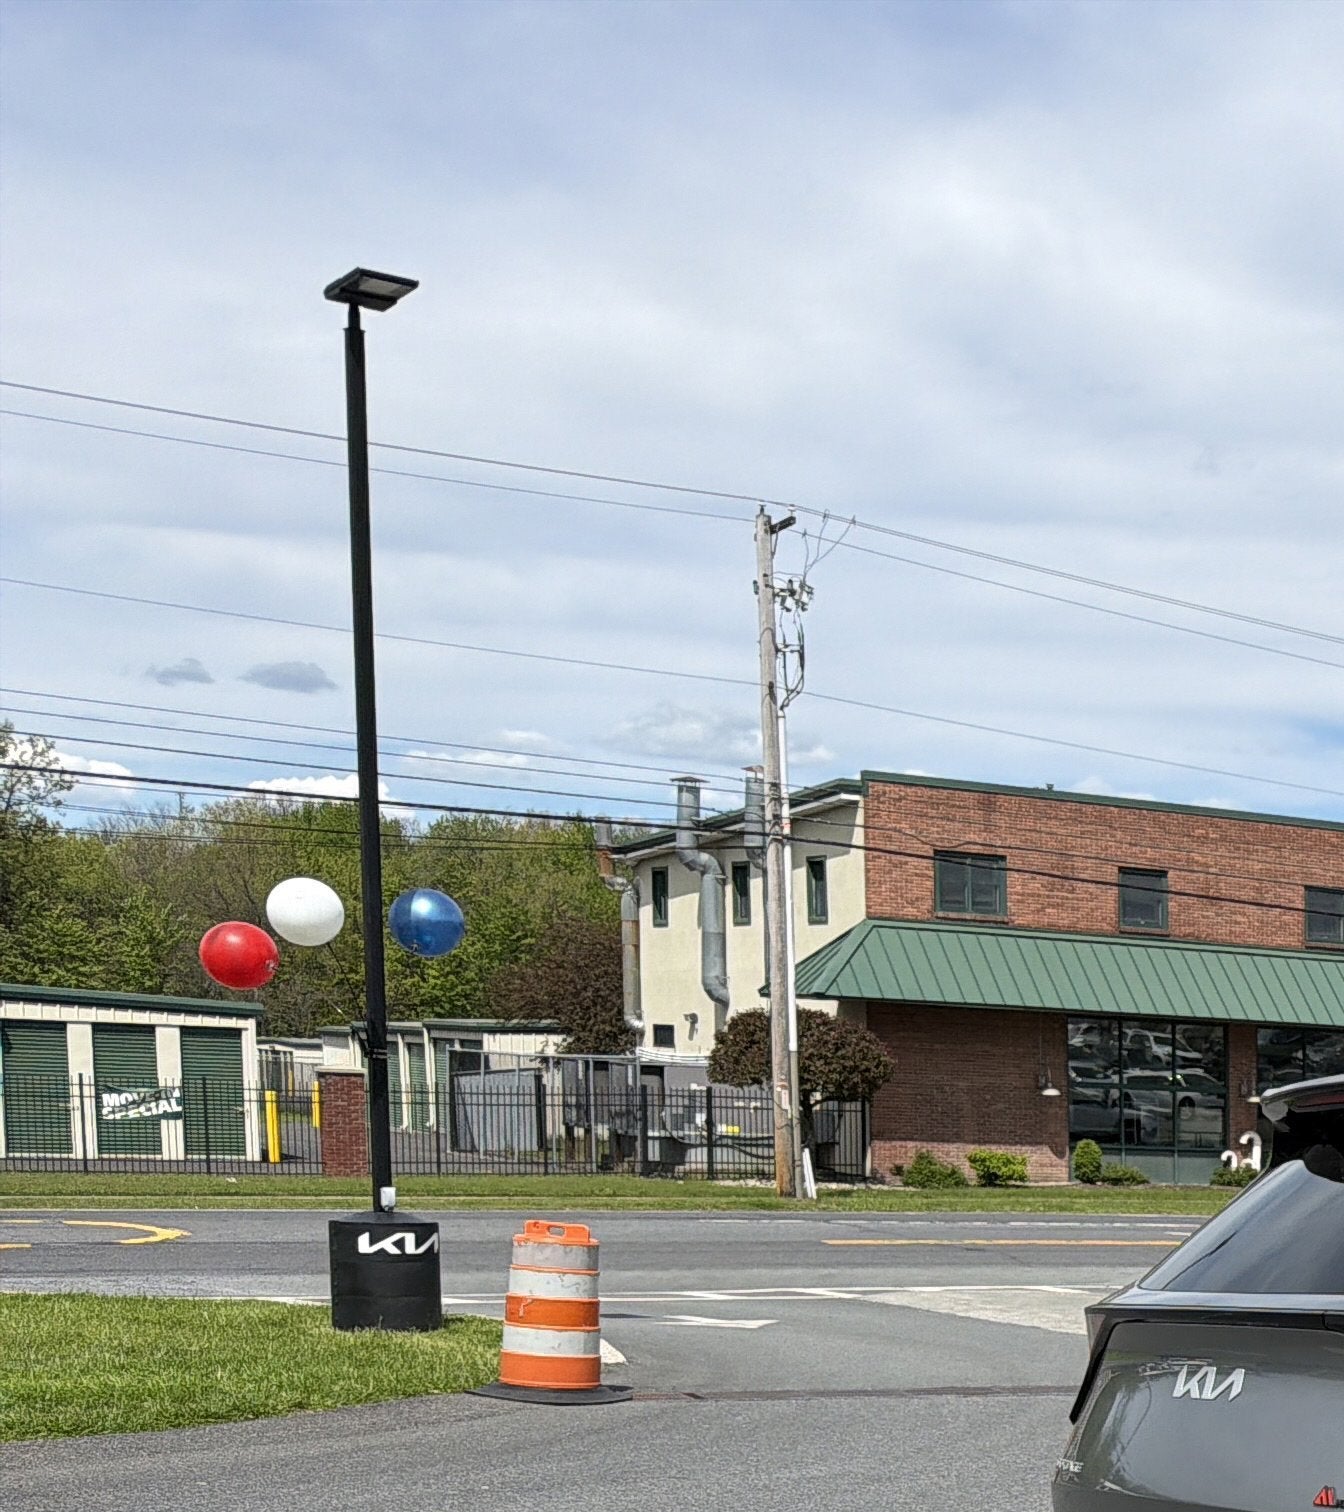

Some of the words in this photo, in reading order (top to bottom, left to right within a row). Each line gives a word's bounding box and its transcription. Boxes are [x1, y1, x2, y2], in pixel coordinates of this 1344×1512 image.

[102, 1098, 182, 1119] SPECIAL
[357, 1231, 439, 1255] KIA
[1172, 1364, 1246, 1402] KIA
